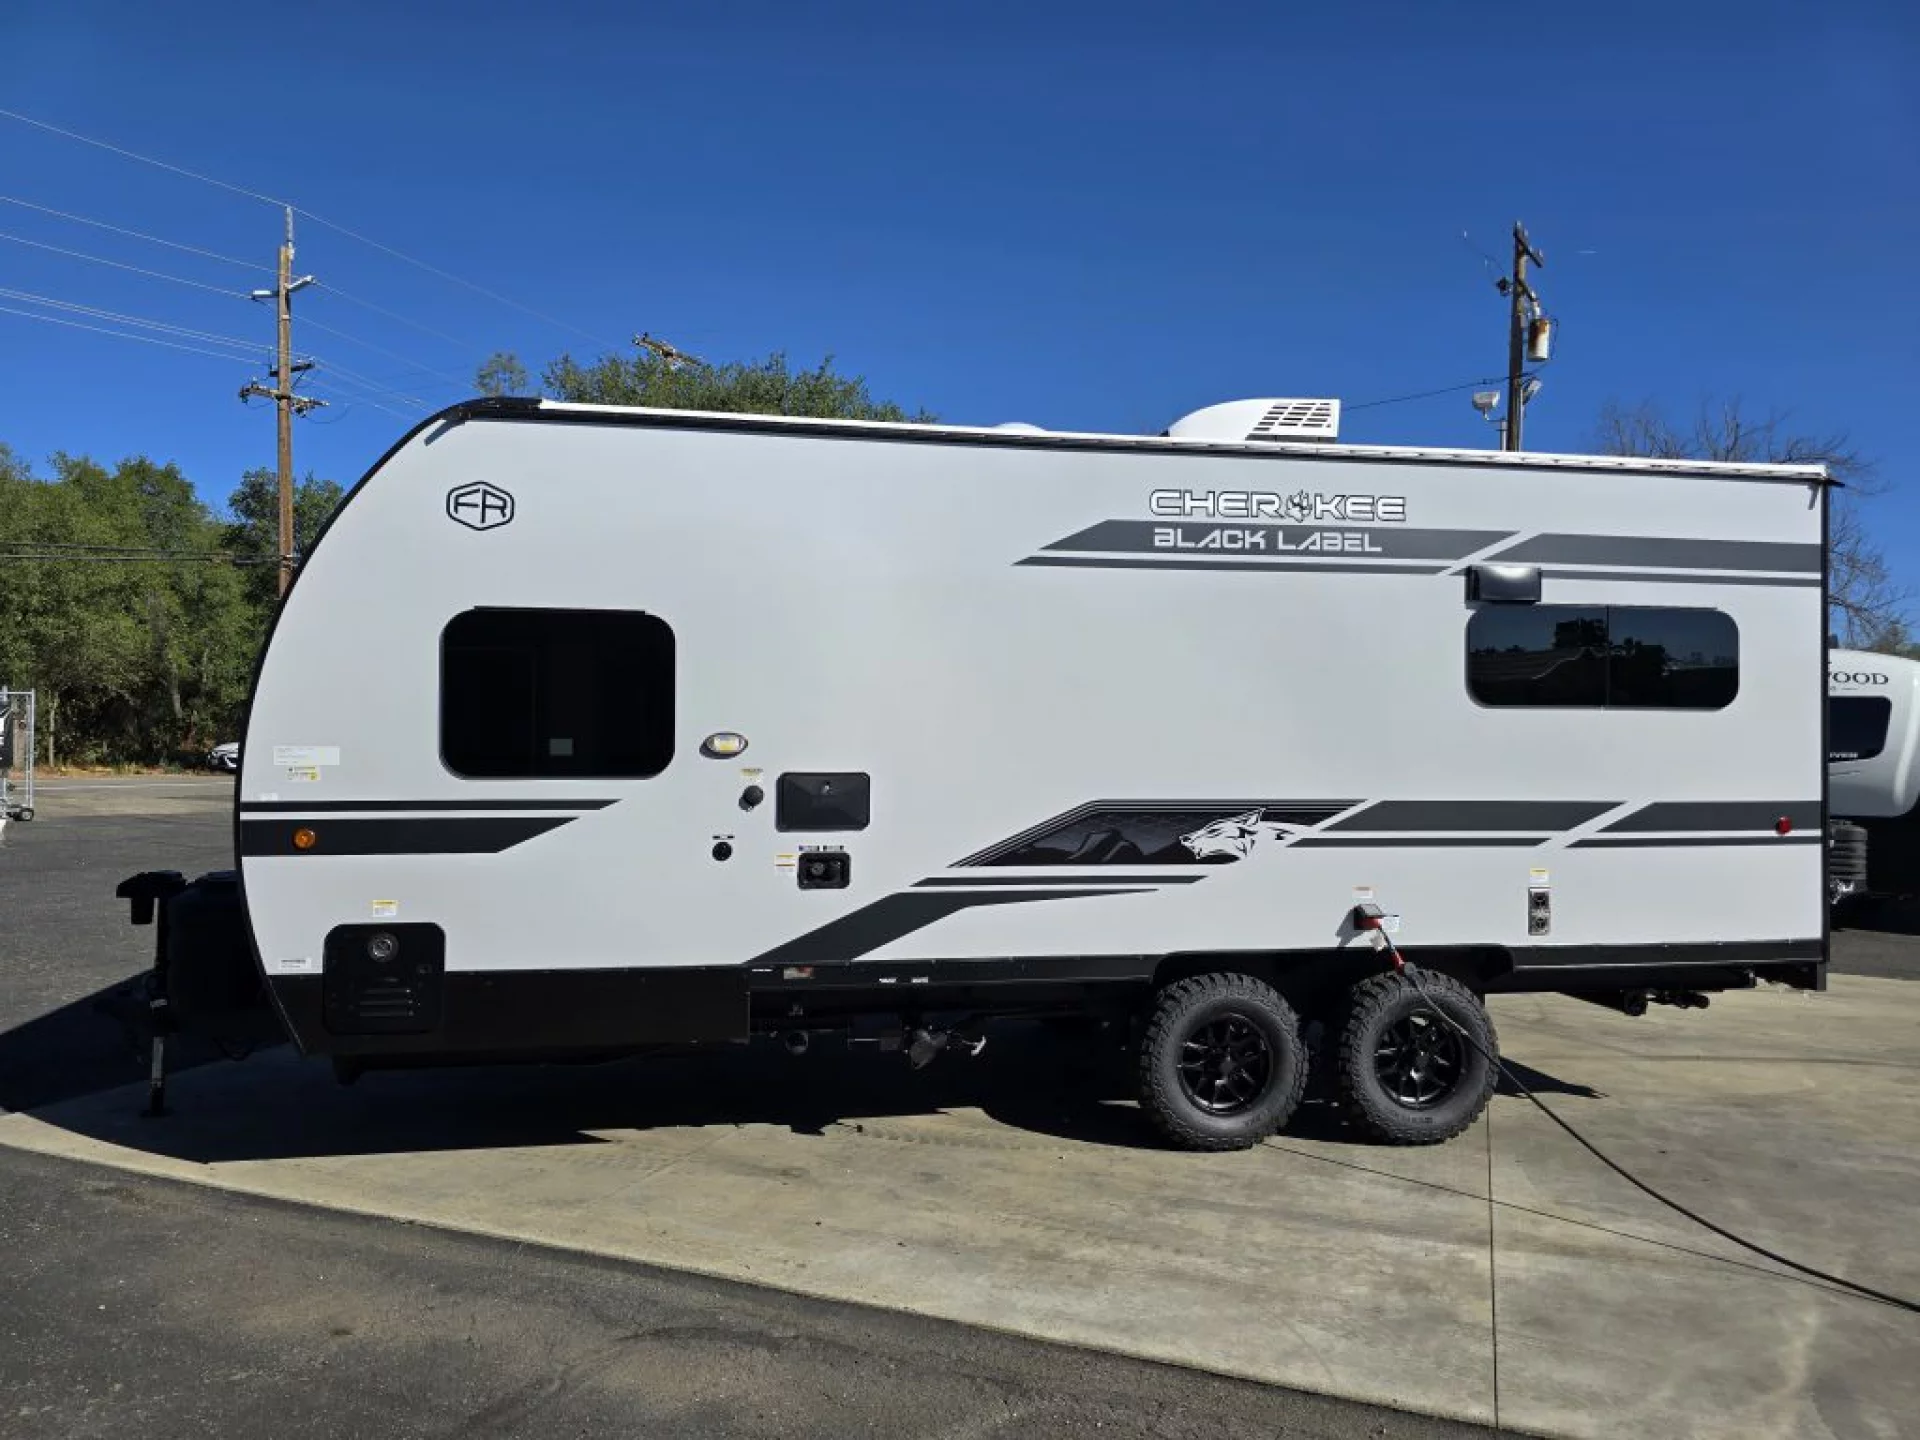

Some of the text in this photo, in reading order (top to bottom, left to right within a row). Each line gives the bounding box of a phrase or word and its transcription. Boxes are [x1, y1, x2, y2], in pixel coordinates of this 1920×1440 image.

[453, 487, 507, 524] FR
[1149, 489, 1406, 523] CHEROKEE
[1154, 527, 1383, 552] BLACK LABEL
[1829, 671, 1889, 685] OOD
